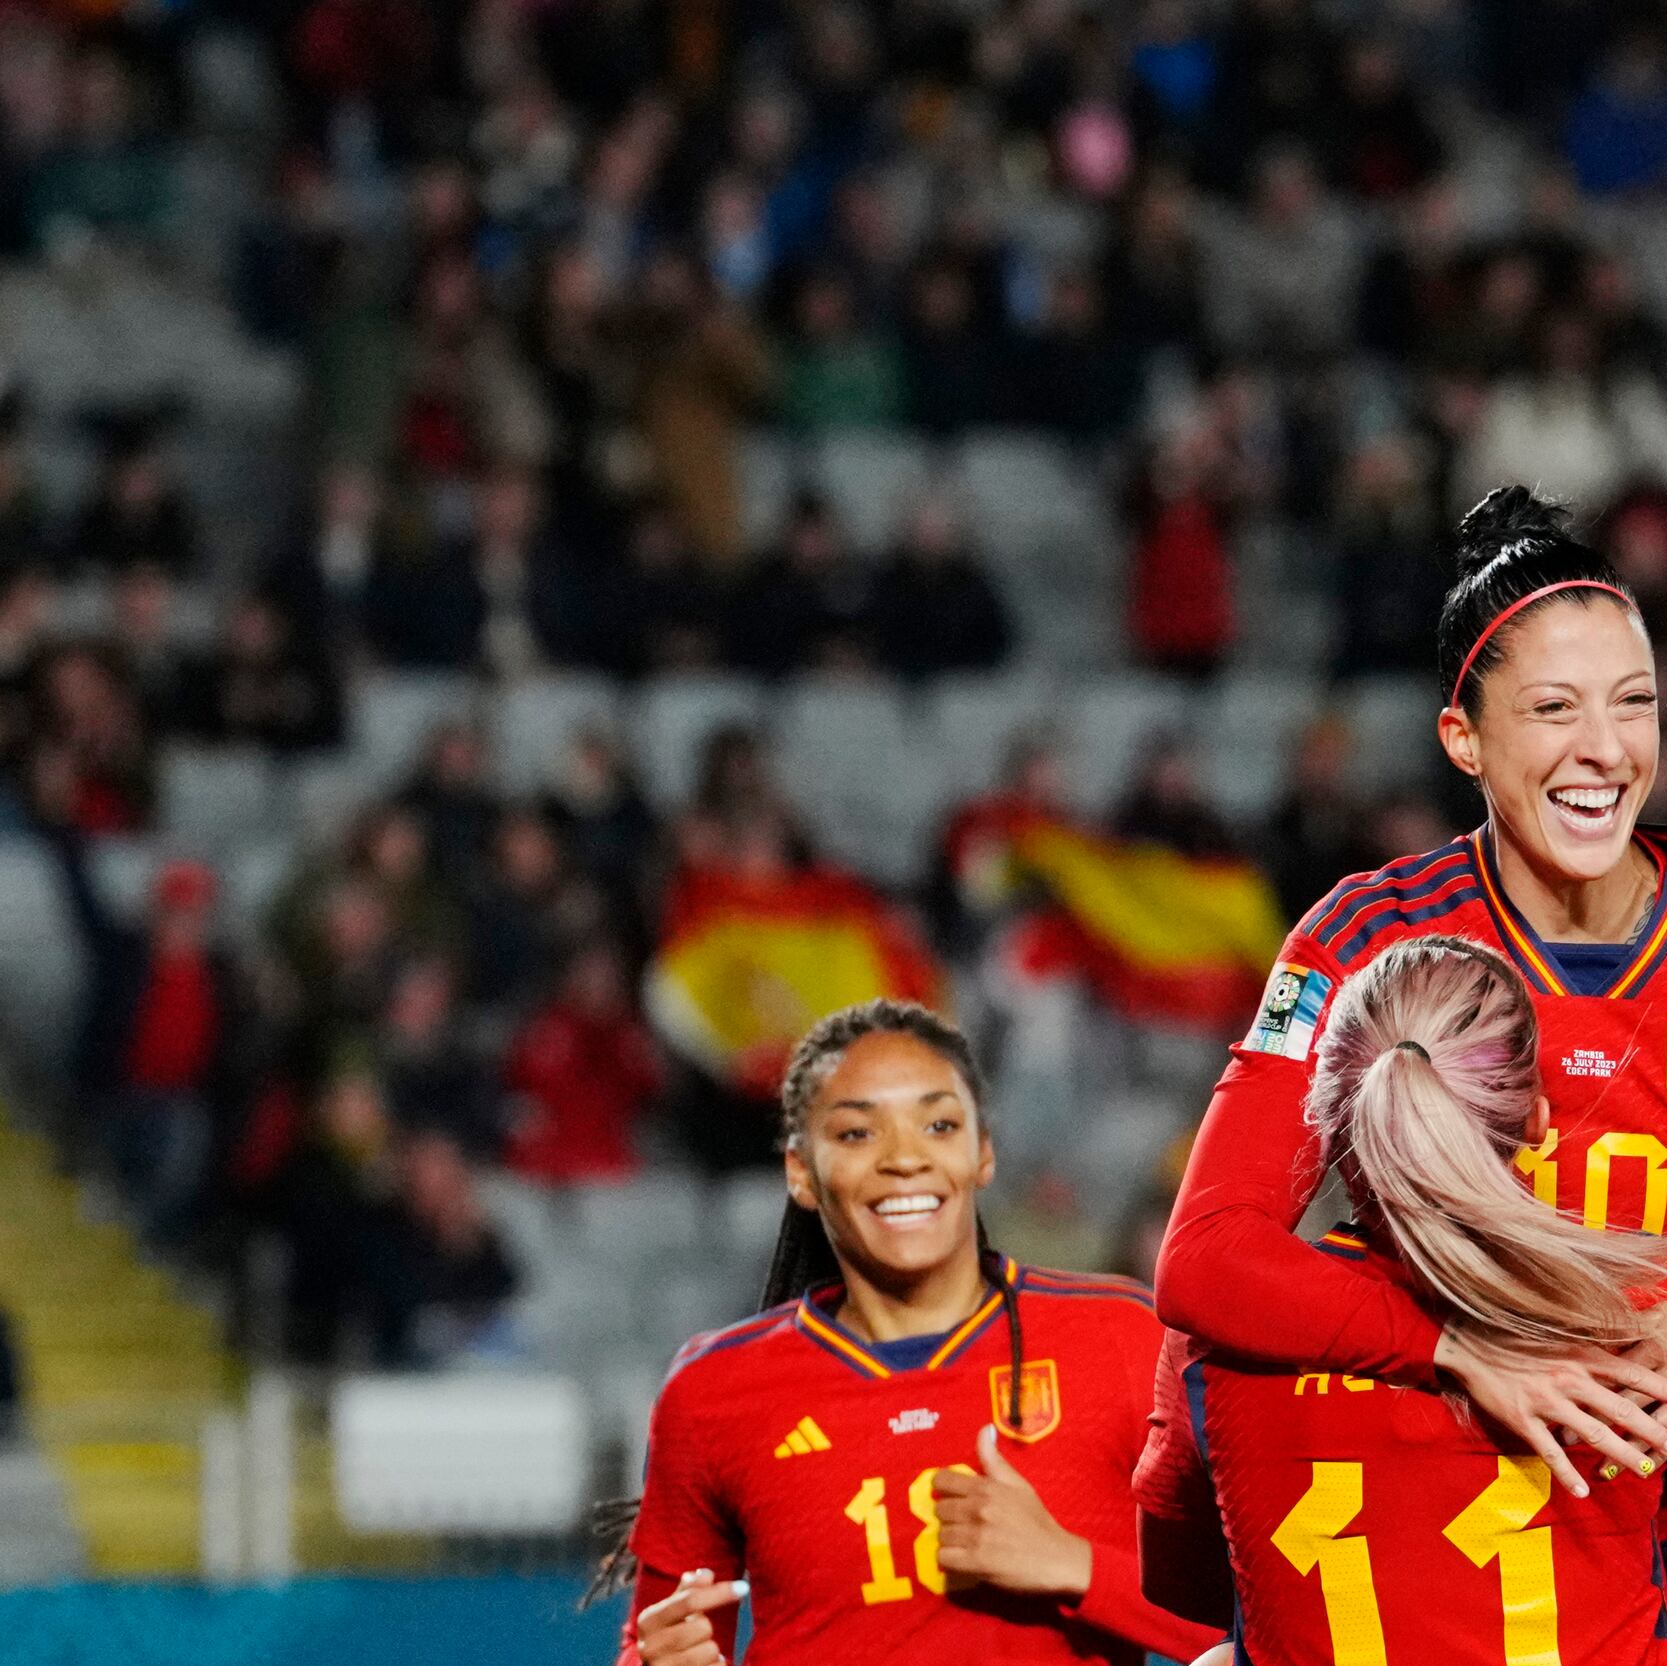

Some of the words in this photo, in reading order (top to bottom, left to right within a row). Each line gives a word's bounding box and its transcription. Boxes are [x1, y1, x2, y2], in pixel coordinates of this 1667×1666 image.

[1573, 1049, 1605, 1059] ZAMBIA
[1561, 1057, 1572, 1066] 26
[1574, 1058, 1594, 1067] JULY
[1595, 1060, 1617, 1069] 2023
[1566, 1066, 1588, 1075] EDEN
[1590, 1067, 1612, 1077] PARK
